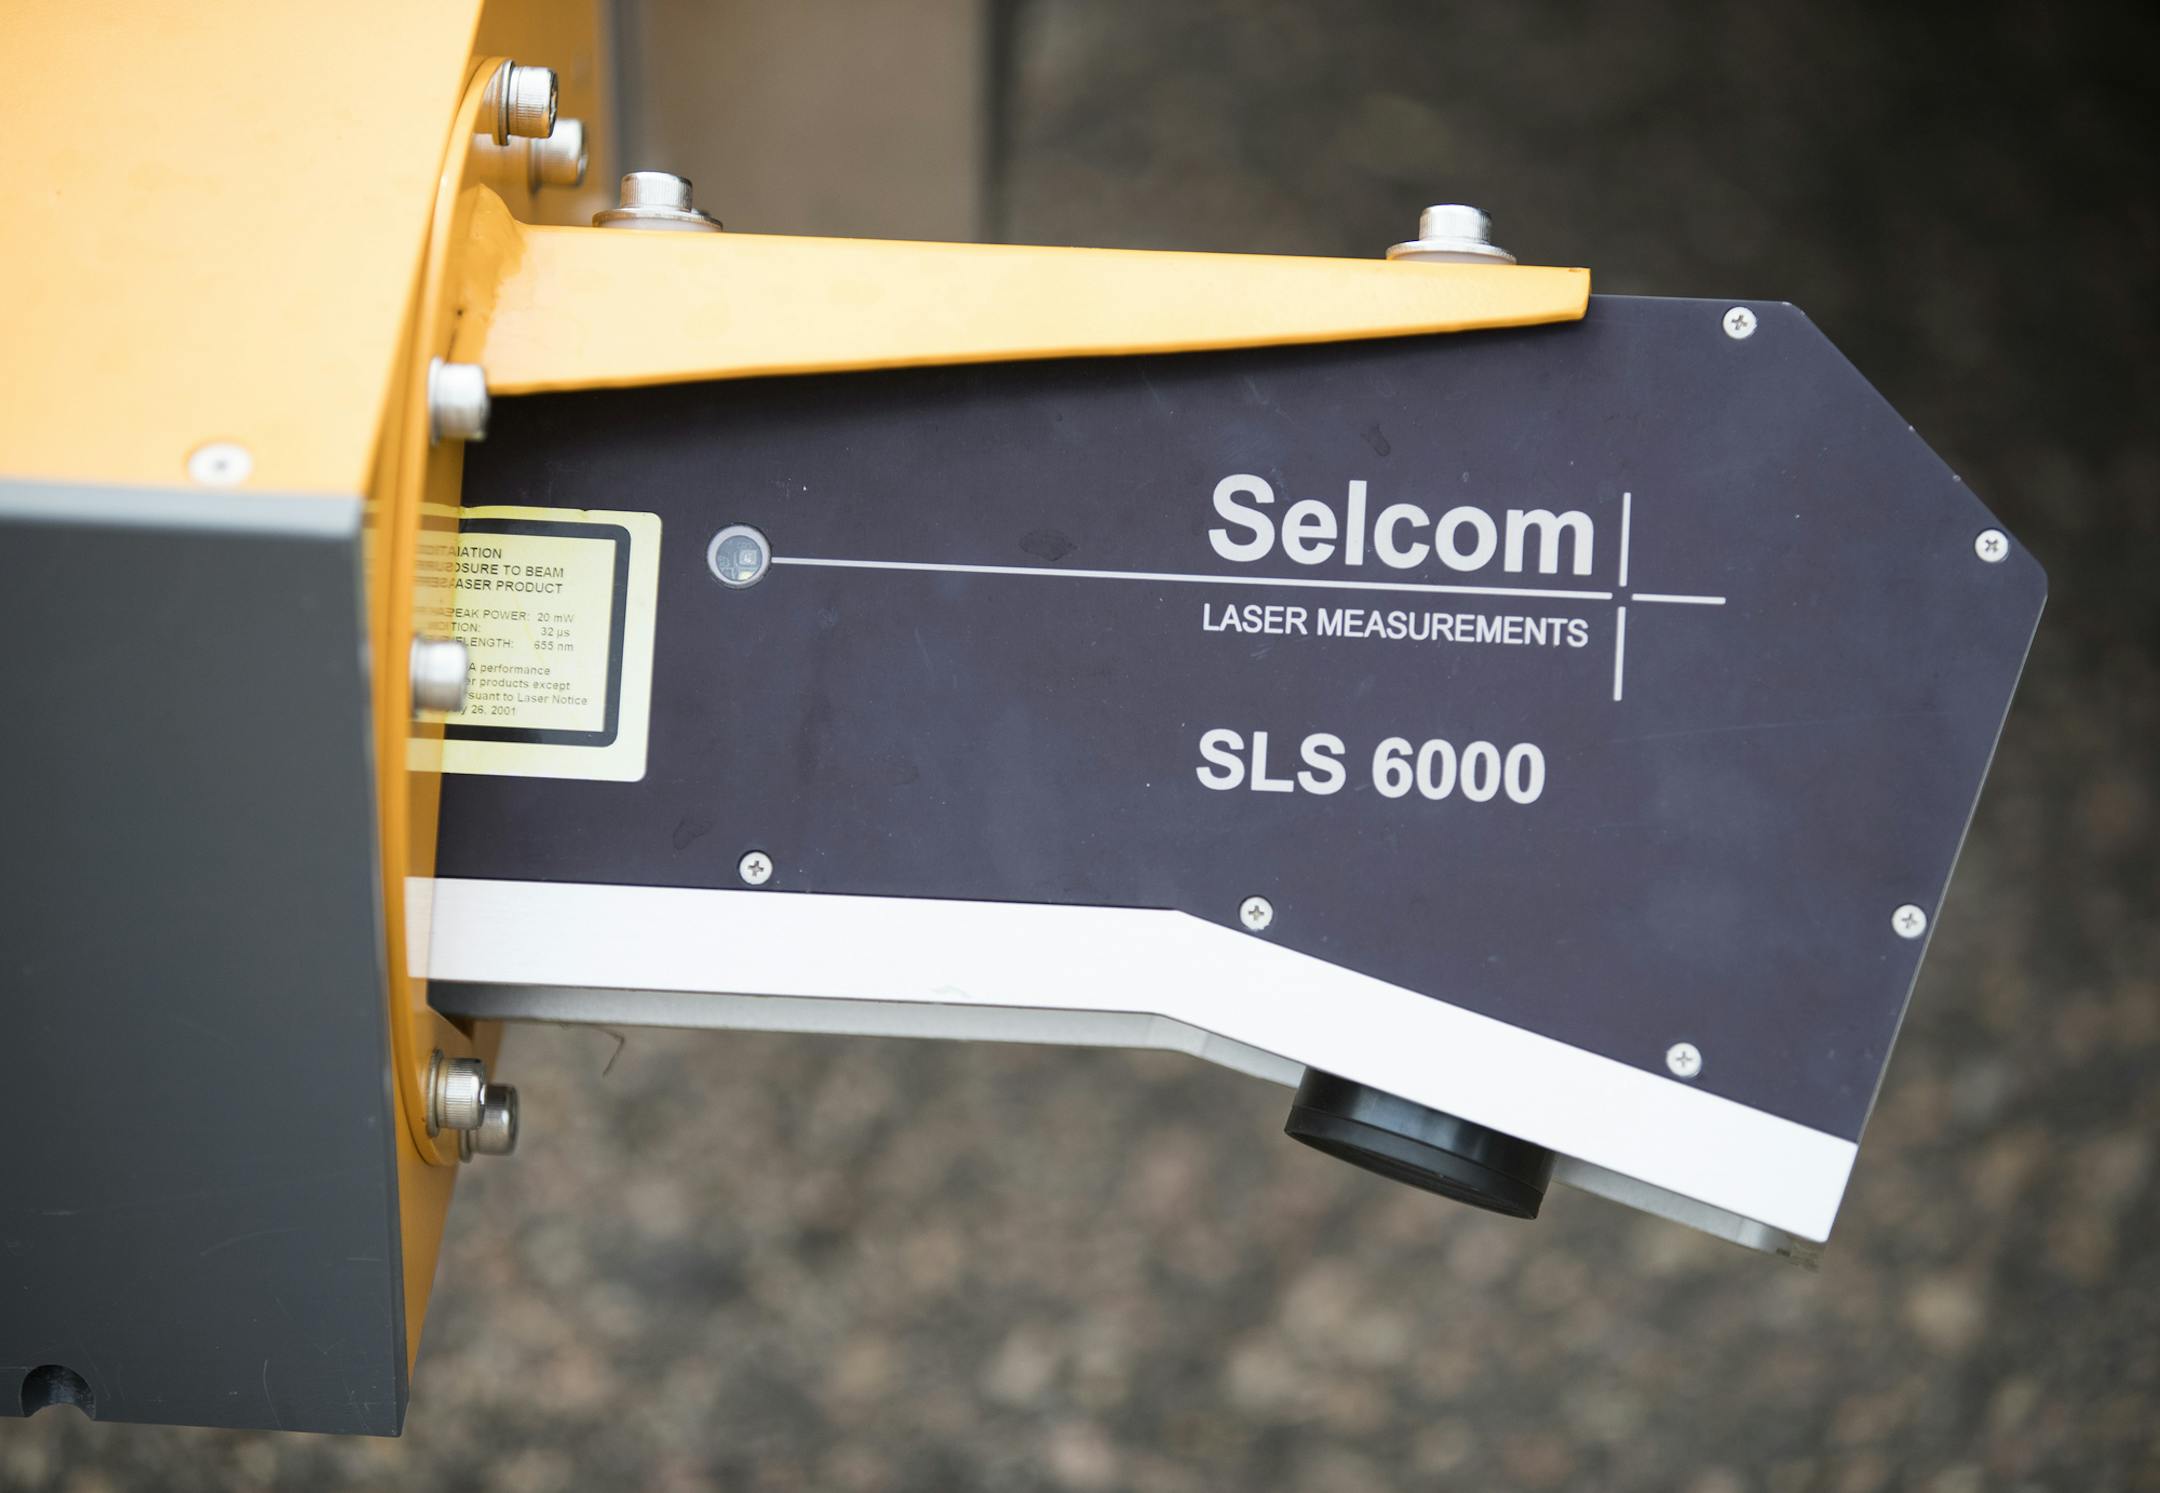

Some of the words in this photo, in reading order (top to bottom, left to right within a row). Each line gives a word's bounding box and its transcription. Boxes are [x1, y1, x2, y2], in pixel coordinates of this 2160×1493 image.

[1208, 473, 1594, 576] Selcom
[503, 564, 521, 576] TO
[525, 566, 564, 578] BEAM
[495, 580, 562, 594] PRODUCT
[482, 608, 530, 621] POWER:
[537, 612, 550, 622] 20
[553, 614, 575, 623] mW
[540, 627, 554, 637] 32
[1202, 603, 1308, 635] LASER
[1316, 607, 1589, 648] MEASUREMENTS
[534, 640, 554, 651] 655
[557, 642, 574, 652] nm
[480, 663, 550, 676] performance
[479, 678, 529, 689] products
[532, 681, 570, 692] except
[503, 692, 513, 702] to
[517, 692, 548, 703] Laser
[552, 694, 588, 705] Notice
[491, 705, 516, 716] 2001
[1196, 728, 1346, 795] SLS
[1372, 736, 1546, 804] 6000
